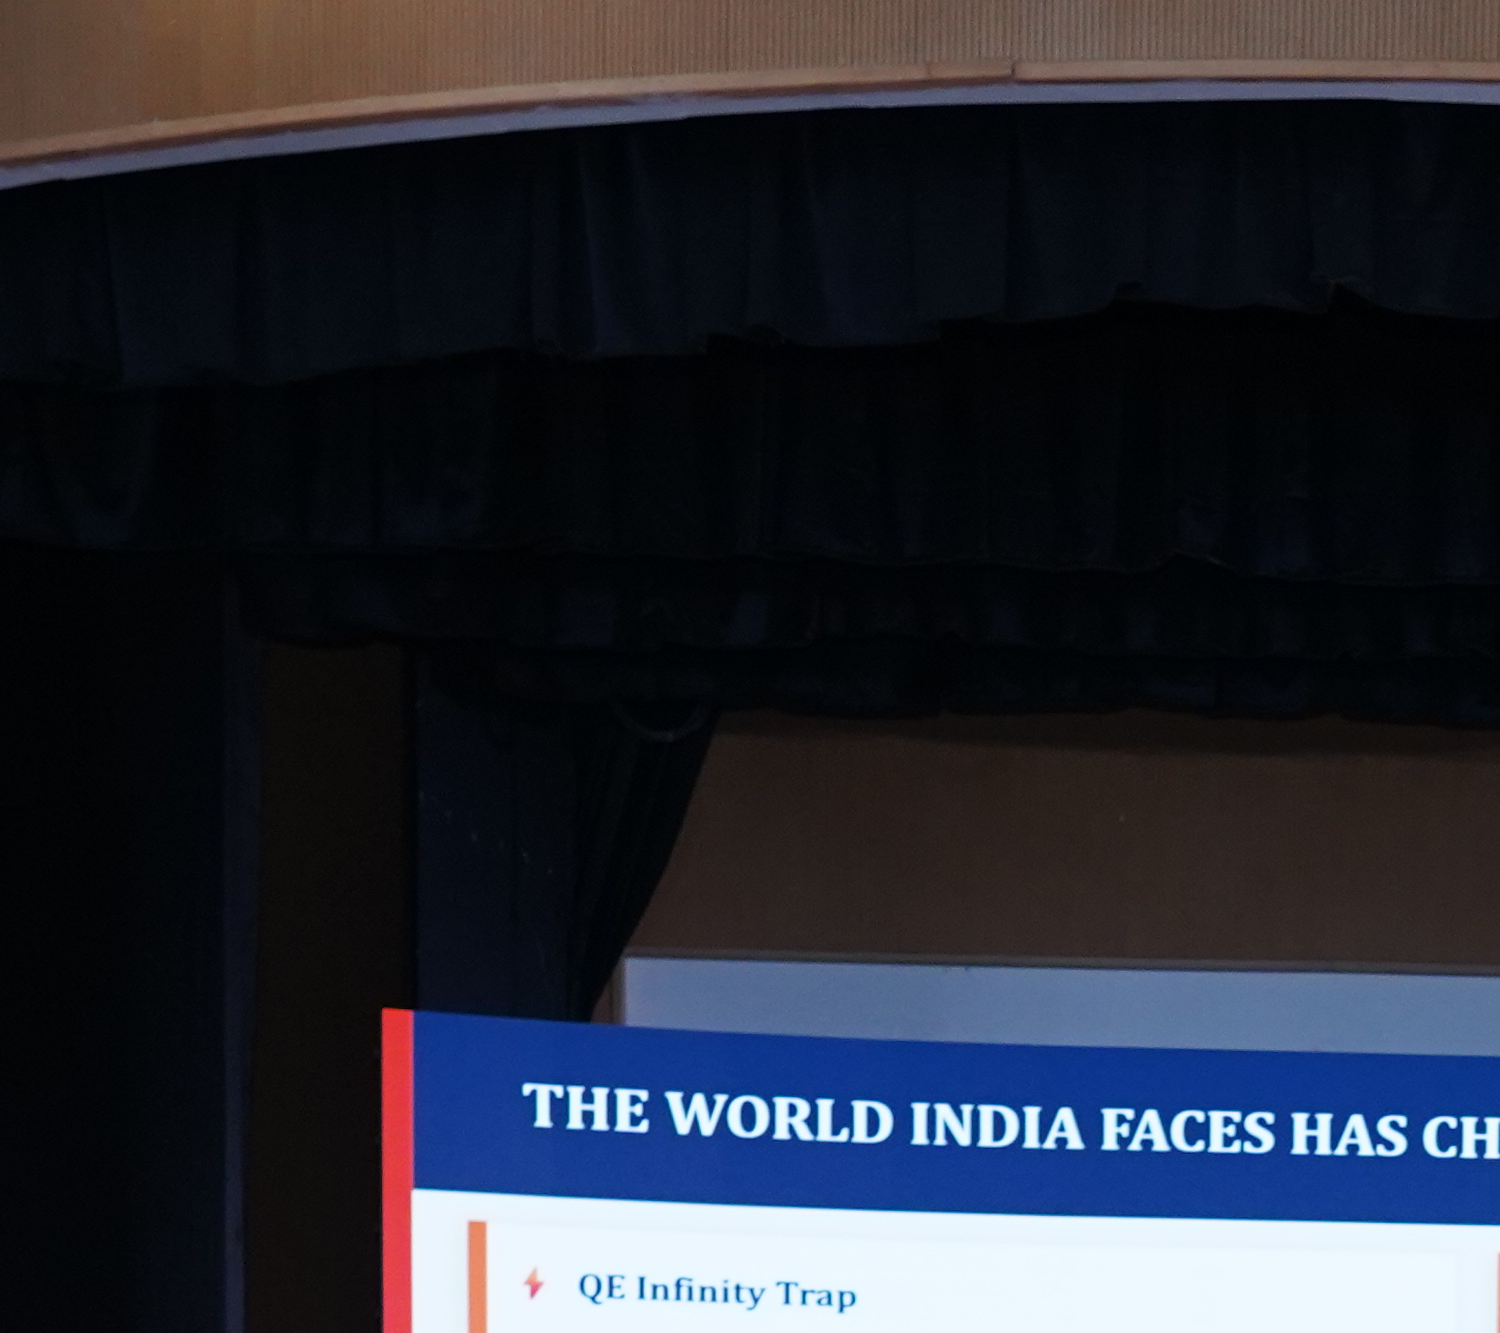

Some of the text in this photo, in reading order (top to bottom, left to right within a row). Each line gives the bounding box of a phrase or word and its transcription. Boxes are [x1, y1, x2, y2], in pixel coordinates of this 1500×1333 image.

[520, 1081, 651, 1134] THE
[663, 1091, 895, 1144] WORLD
[909, 1101, 1087, 1151] INDIA
[1099, 1106, 1277, 1155] FACES
[1289, 1111, 1409, 1158] HAS
[577, 1272, 858, 1315] QE Infinity Trap
